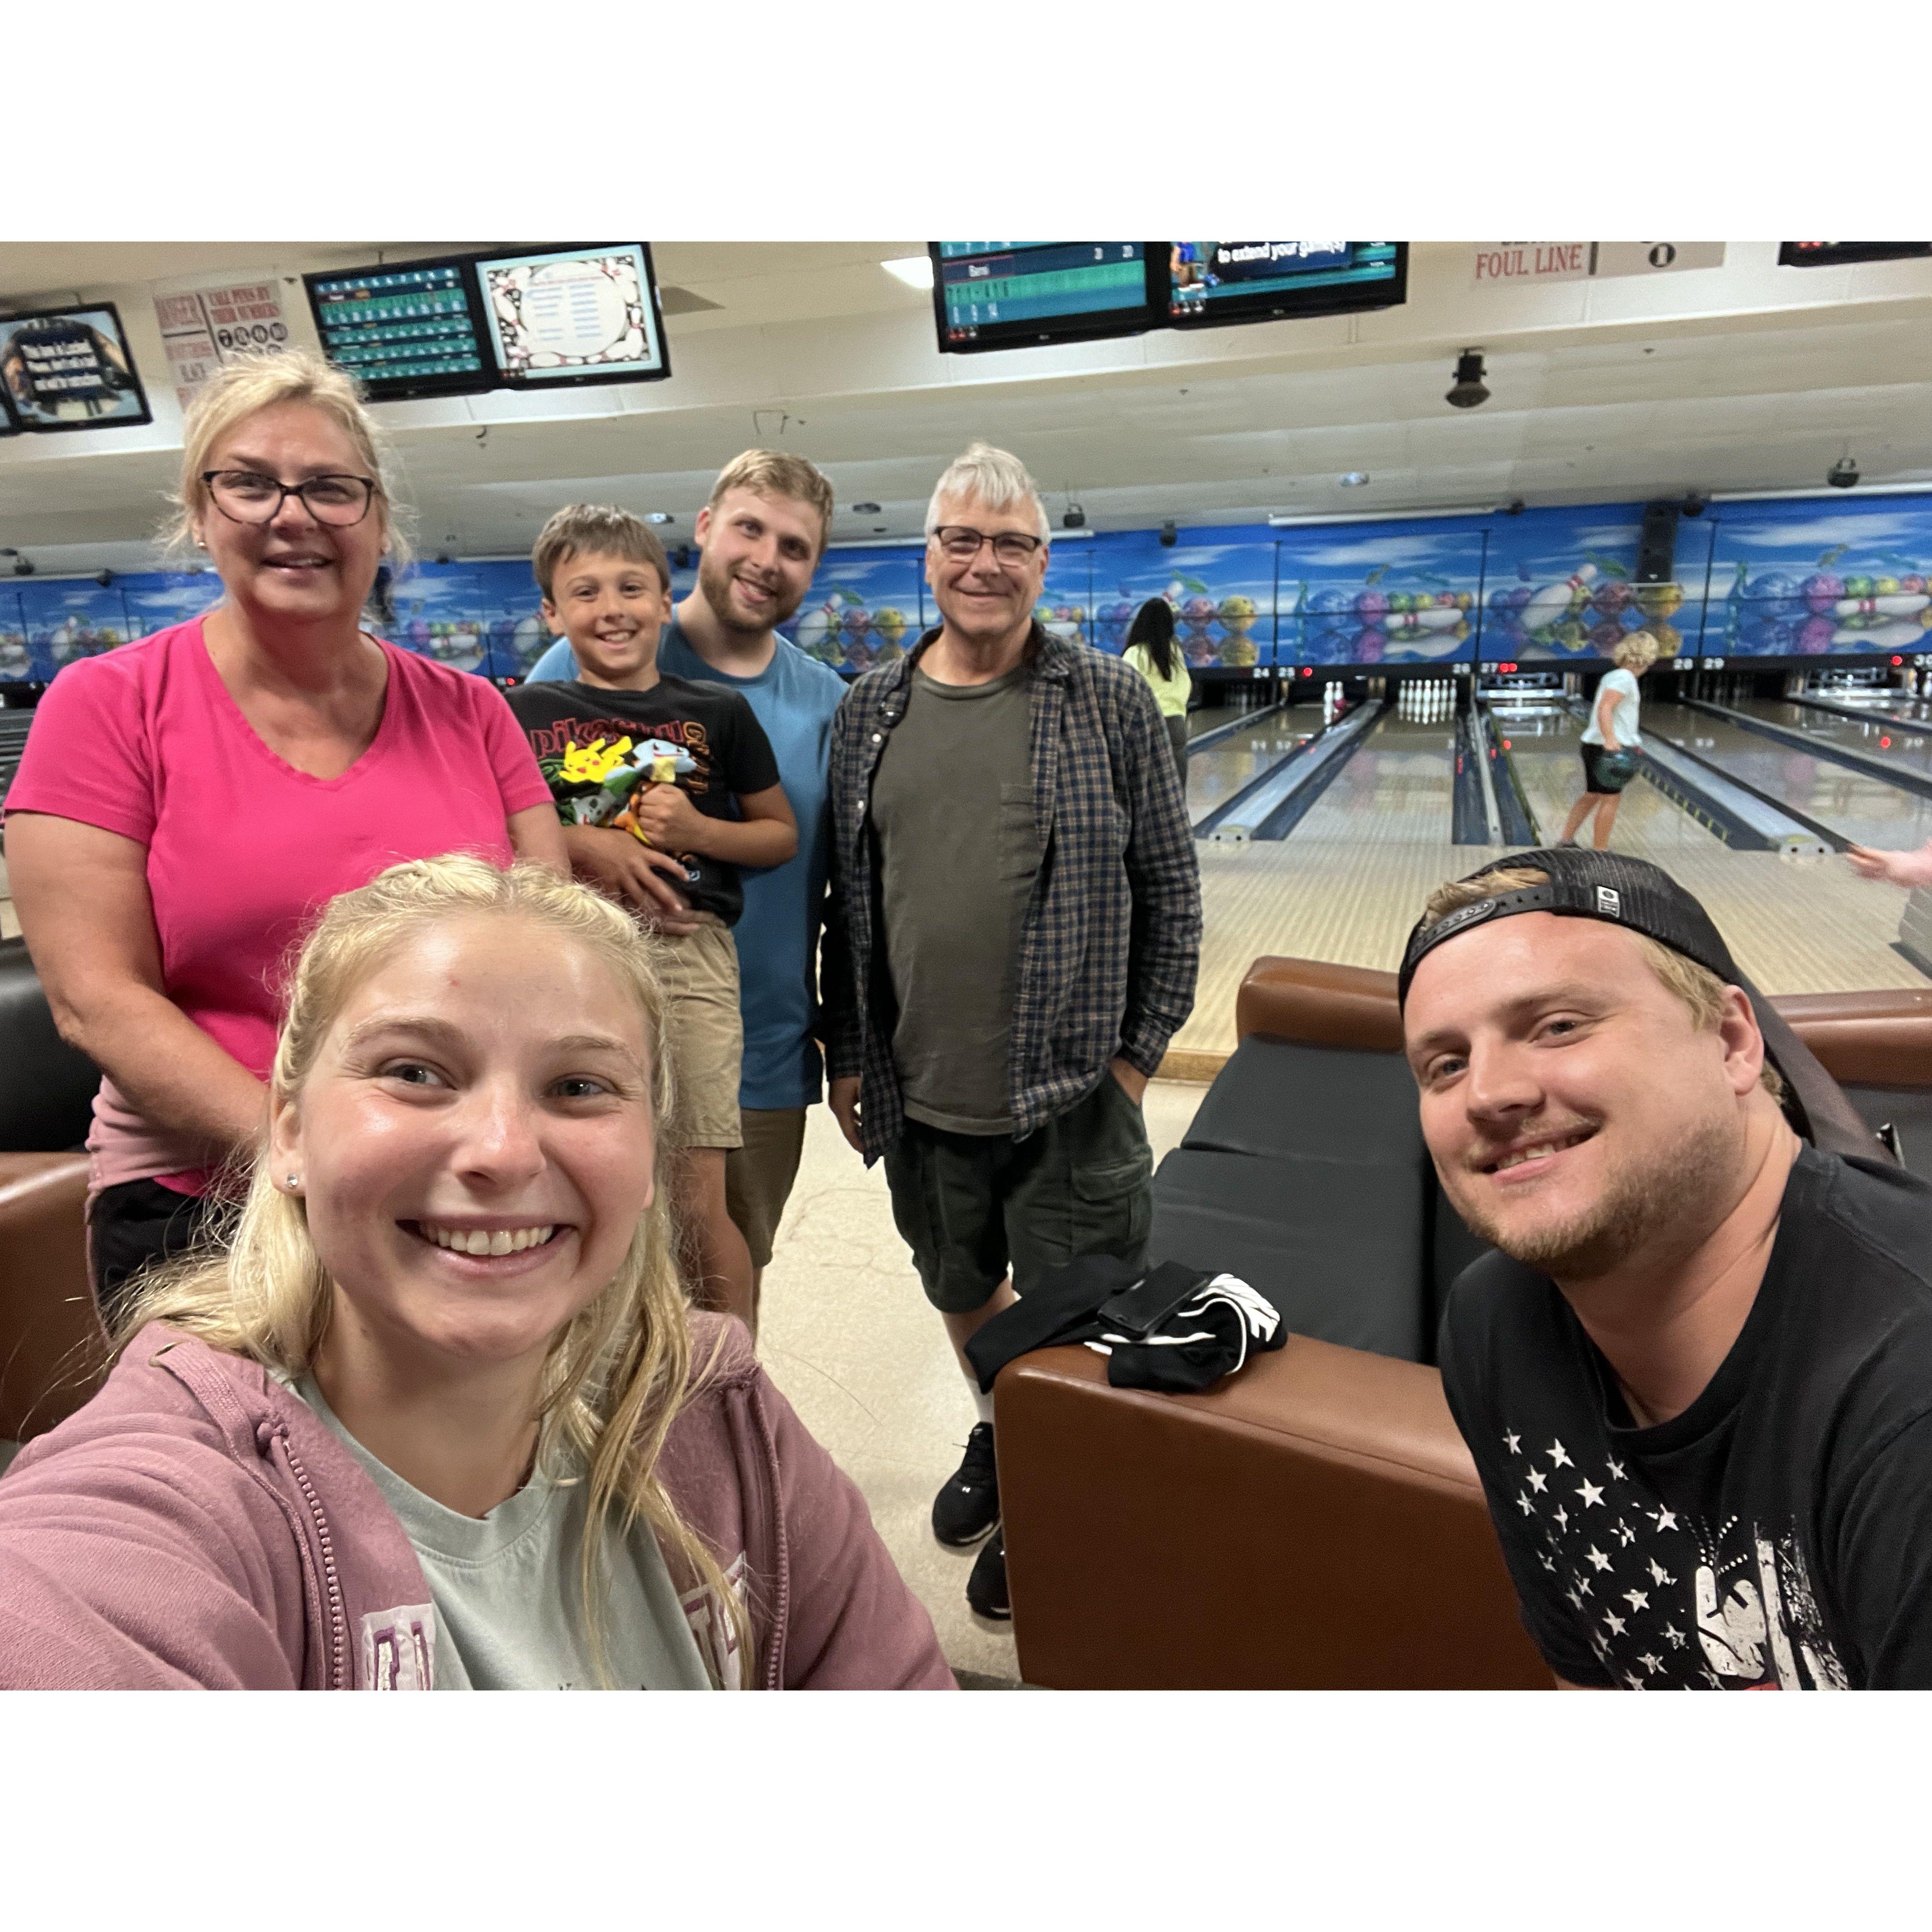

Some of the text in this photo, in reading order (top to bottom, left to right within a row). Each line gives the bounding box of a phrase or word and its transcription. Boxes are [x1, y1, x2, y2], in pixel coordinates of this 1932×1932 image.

[1218, 248, 1230, 263] to
[1232, 242, 1269, 261] extend
[1271, 242, 1298, 261] your
[1475, 244, 1583, 279] FOUL LINE
[1703, 657, 1725, 670] 29
